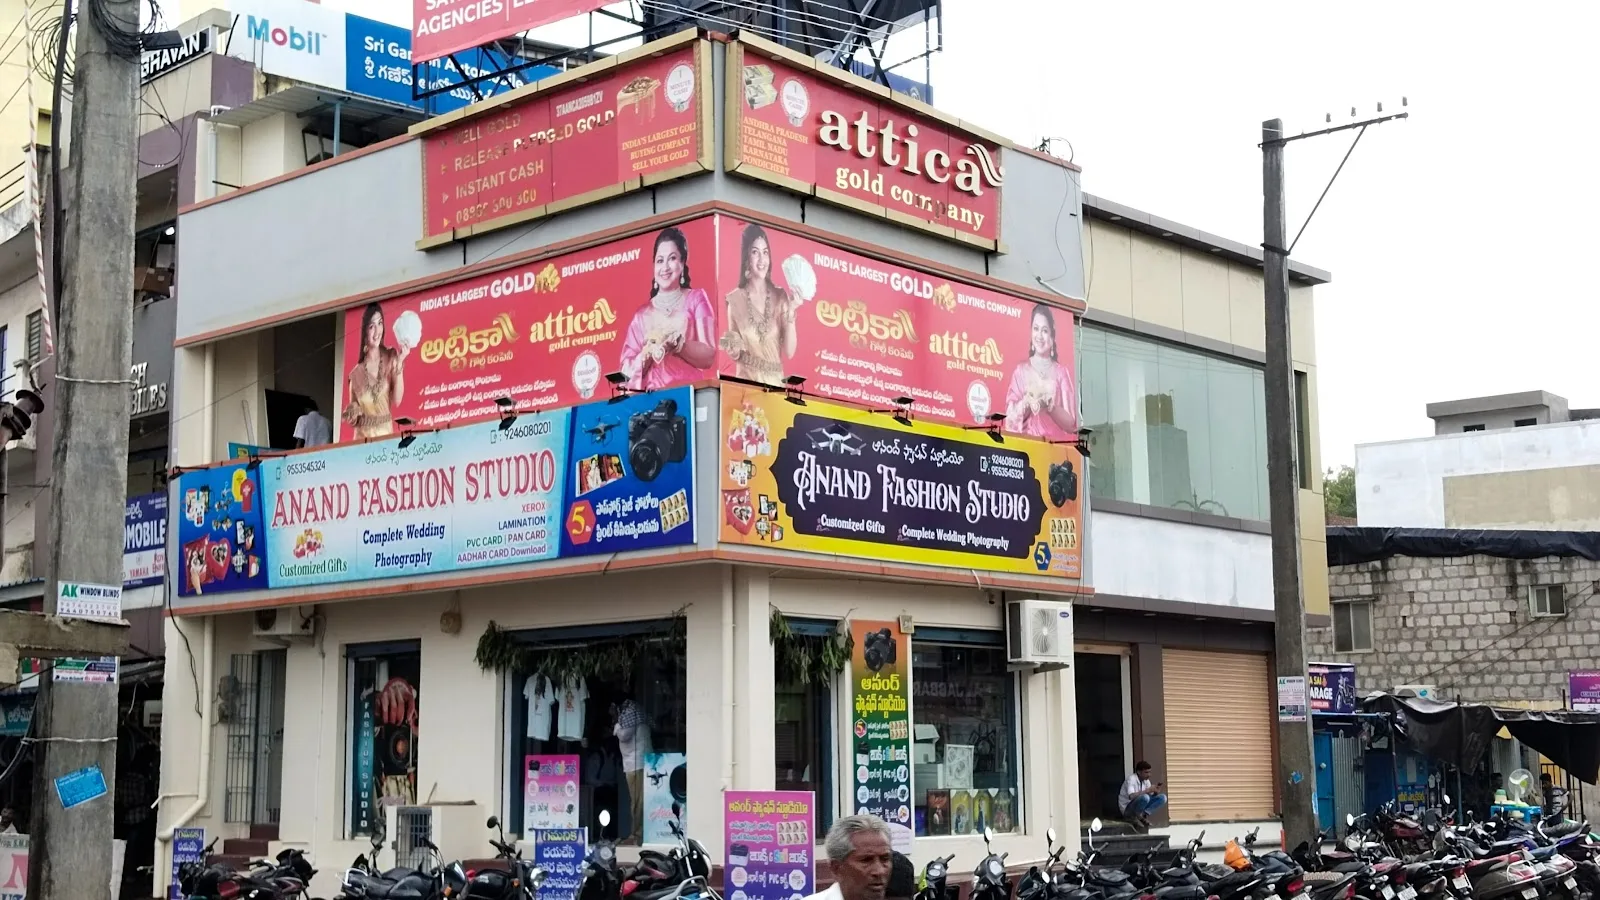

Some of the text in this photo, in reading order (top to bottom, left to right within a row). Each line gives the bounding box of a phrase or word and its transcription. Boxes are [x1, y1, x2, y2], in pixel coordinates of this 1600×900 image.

[416, 0, 503, 38] AGENCIES
[247, 14, 321, 56] Mobil
[365, 36, 384, 53] Sri
[365, 56, 376, 79] శ్రీ
[577, 110, 614, 133] GOLD
[743, 116, 808, 144] ANDHRA PRADESH
[622, 136, 647, 150] INDIA'S
[648, 127, 678, 142] LARGEST
[743, 126, 787, 146] TELANGANA
[743, 135, 788, 156] TAMIL NADU
[631, 136, 691, 160] BUYING COMPANY
[743, 145, 788, 165] KARNATAKA
[819, 109, 1005, 196] attica
[633, 149, 689, 171] SELL YOUR GOLD
[743, 155, 789, 176] PONDICHERY
[456, 160, 544, 199] INSTANT CASH
[836, 166, 985, 230] gold company
[420, 248, 641, 313] INDIA'S LARGEST GOLD BUYING COMPANY
[814, 252, 1022, 319] INDIA'S LARGEST GOLD BUYING COMPANY
[530, 298, 616, 344] attica
[549, 330, 617, 352] gold company
[929, 331, 1003, 366] attica
[946, 359, 1004, 380] gold company
[504, 421, 551, 440] 9246080201
[286, 459, 326, 476] 9553545324
[991, 454, 1024, 469] 9246080201
[991, 466, 1024, 480] 9553545324
[271, 449, 555, 528] ANAND FASHION STUDIO
[522, 503, 546, 513] XEROX
[498, 515, 546, 531] LAMINATION
[820, 514, 1009, 551] Customized Gifts Complete Wedding Photography
[363, 523, 445, 546] Complete Wedding
[467, 530, 546, 548] PVC CARD PAN CARD
[375, 548, 432, 569] Photography
[457, 544, 546, 563] AADHAR CARD Download
[129, 567, 149, 579] YAMAHA
[279, 558, 347, 578] Customized Gifts
[62, 584, 119, 598] AK WINDOW BLINDS
[861, 672, 900, 691] ఆనంద్
[362, 701, 370, 766] FASHION
[360, 772, 369, 828] STUDIO
